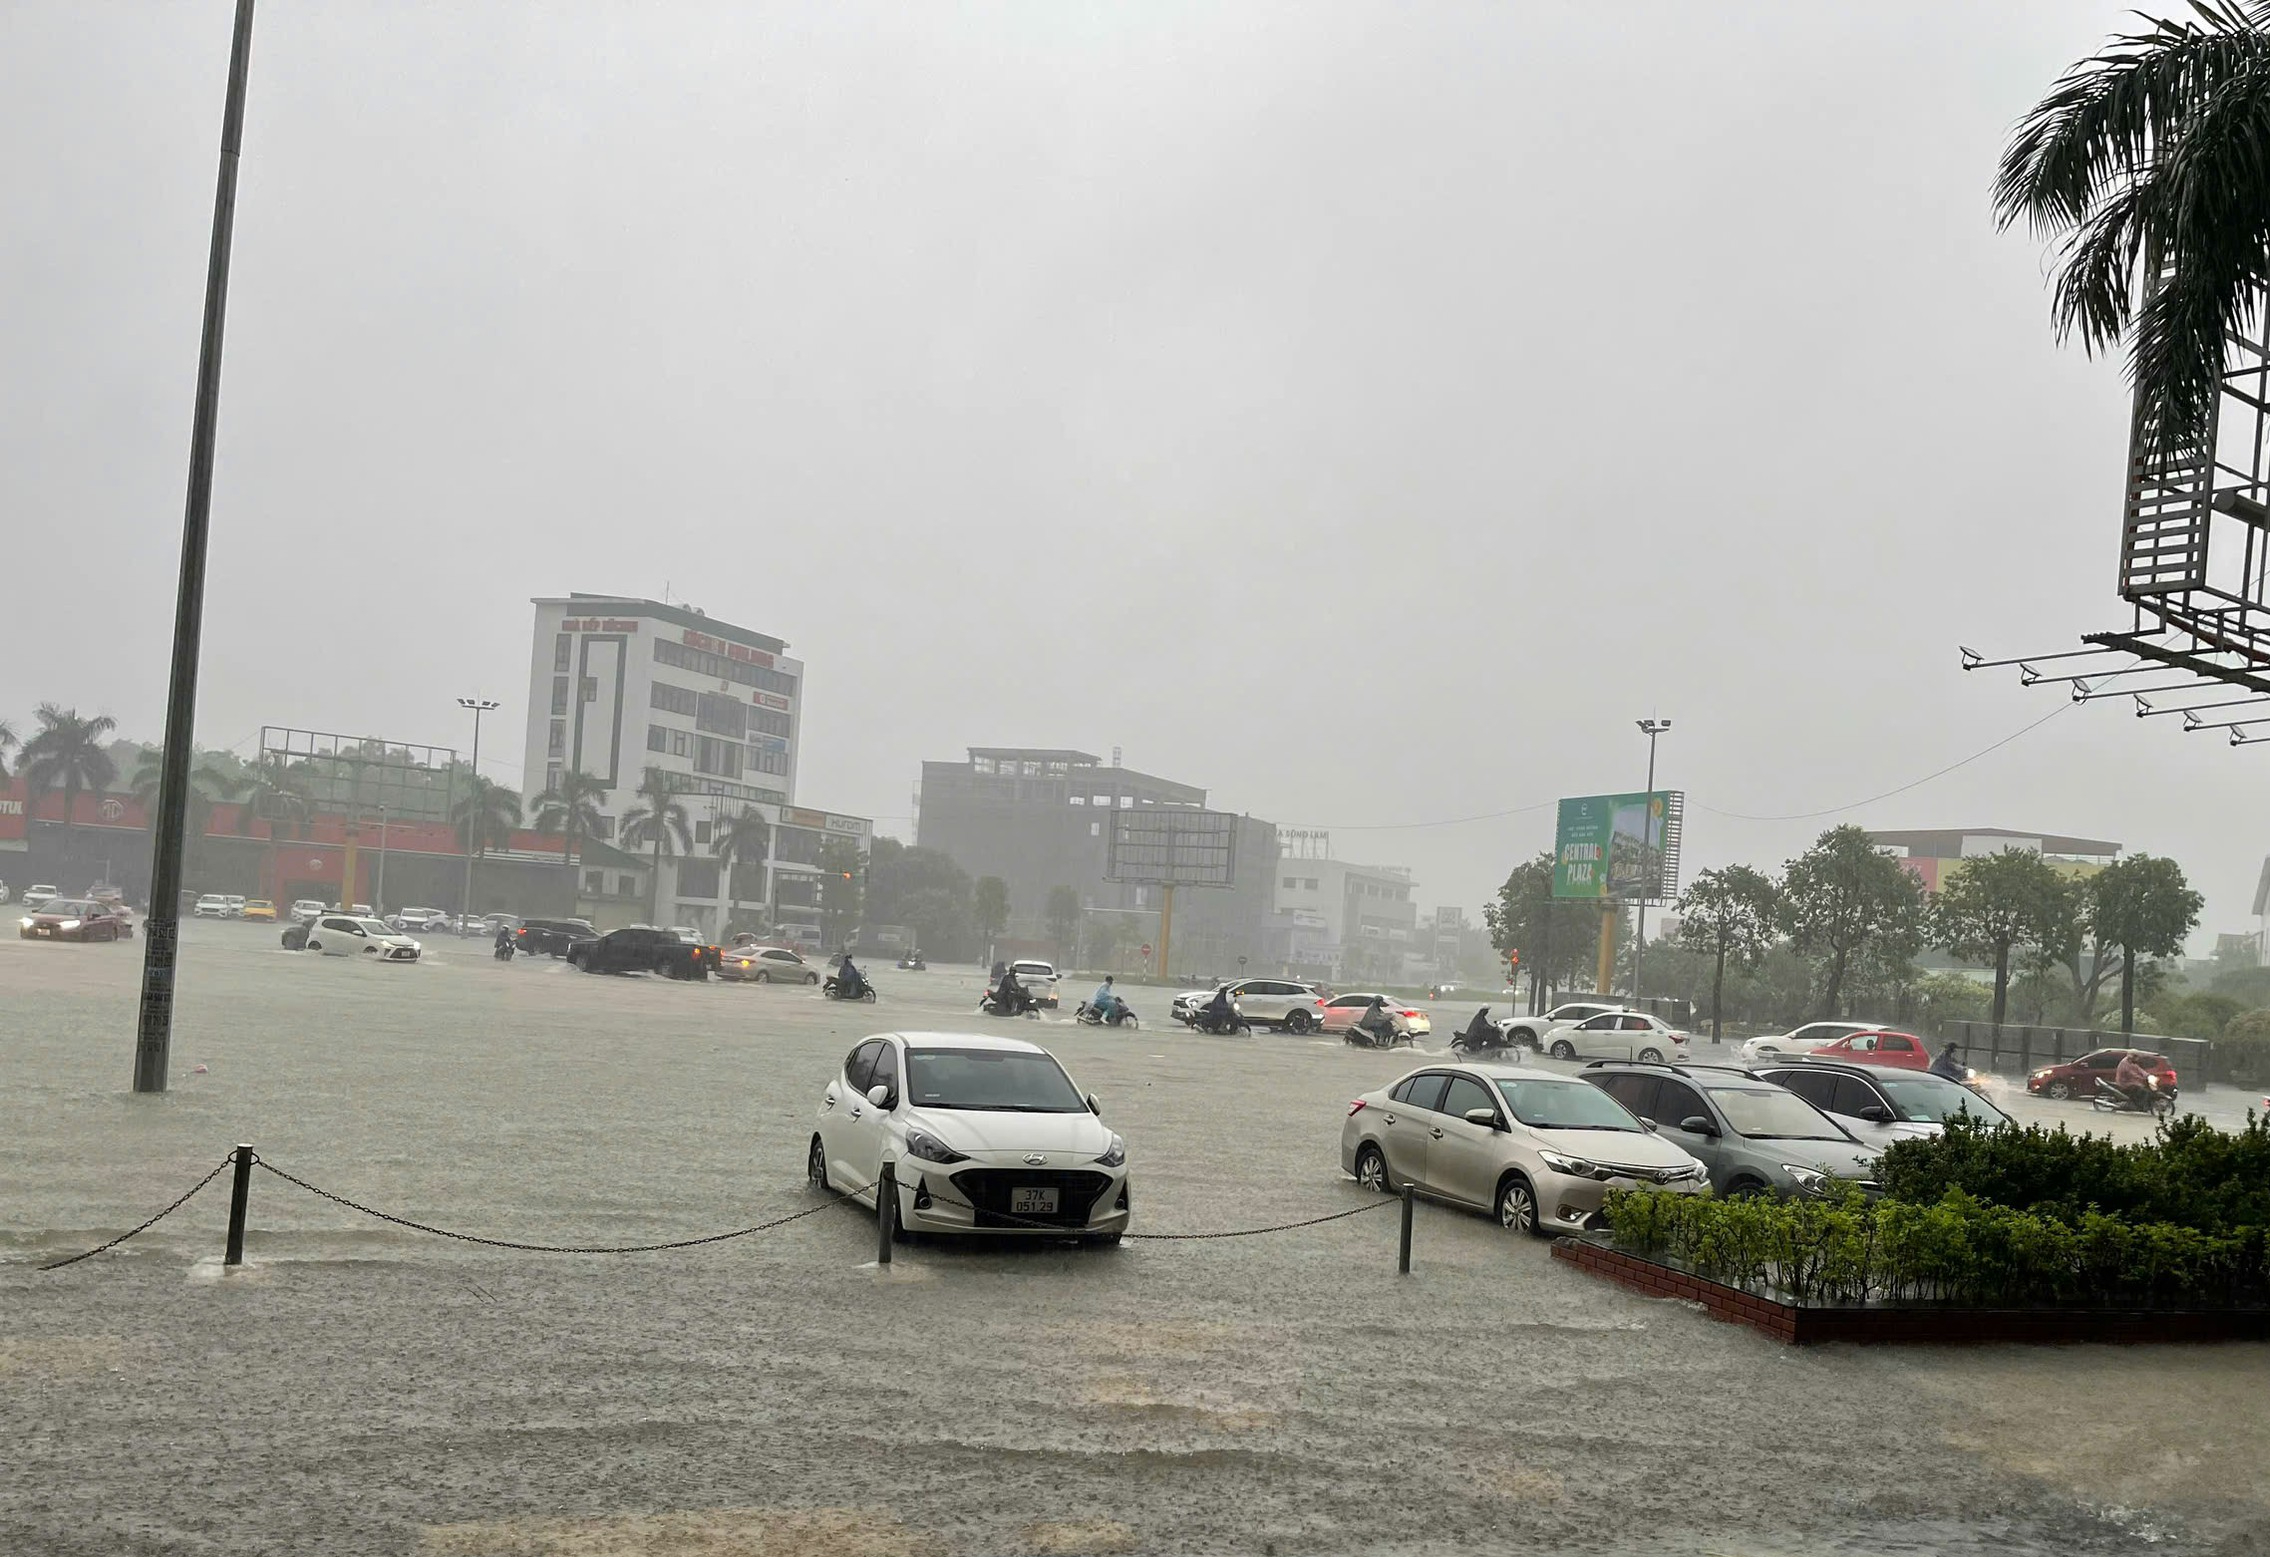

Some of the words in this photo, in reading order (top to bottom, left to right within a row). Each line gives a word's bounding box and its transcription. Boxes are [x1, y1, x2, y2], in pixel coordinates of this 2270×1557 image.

[0, 800, 23, 815] TUL
[1564, 843, 1598, 862] CENTRAL
[1566, 863, 1593, 886] PLAZA
[1026, 1190, 1045, 1200] 37K
[1016, 1202, 1053, 1212] 051.29
